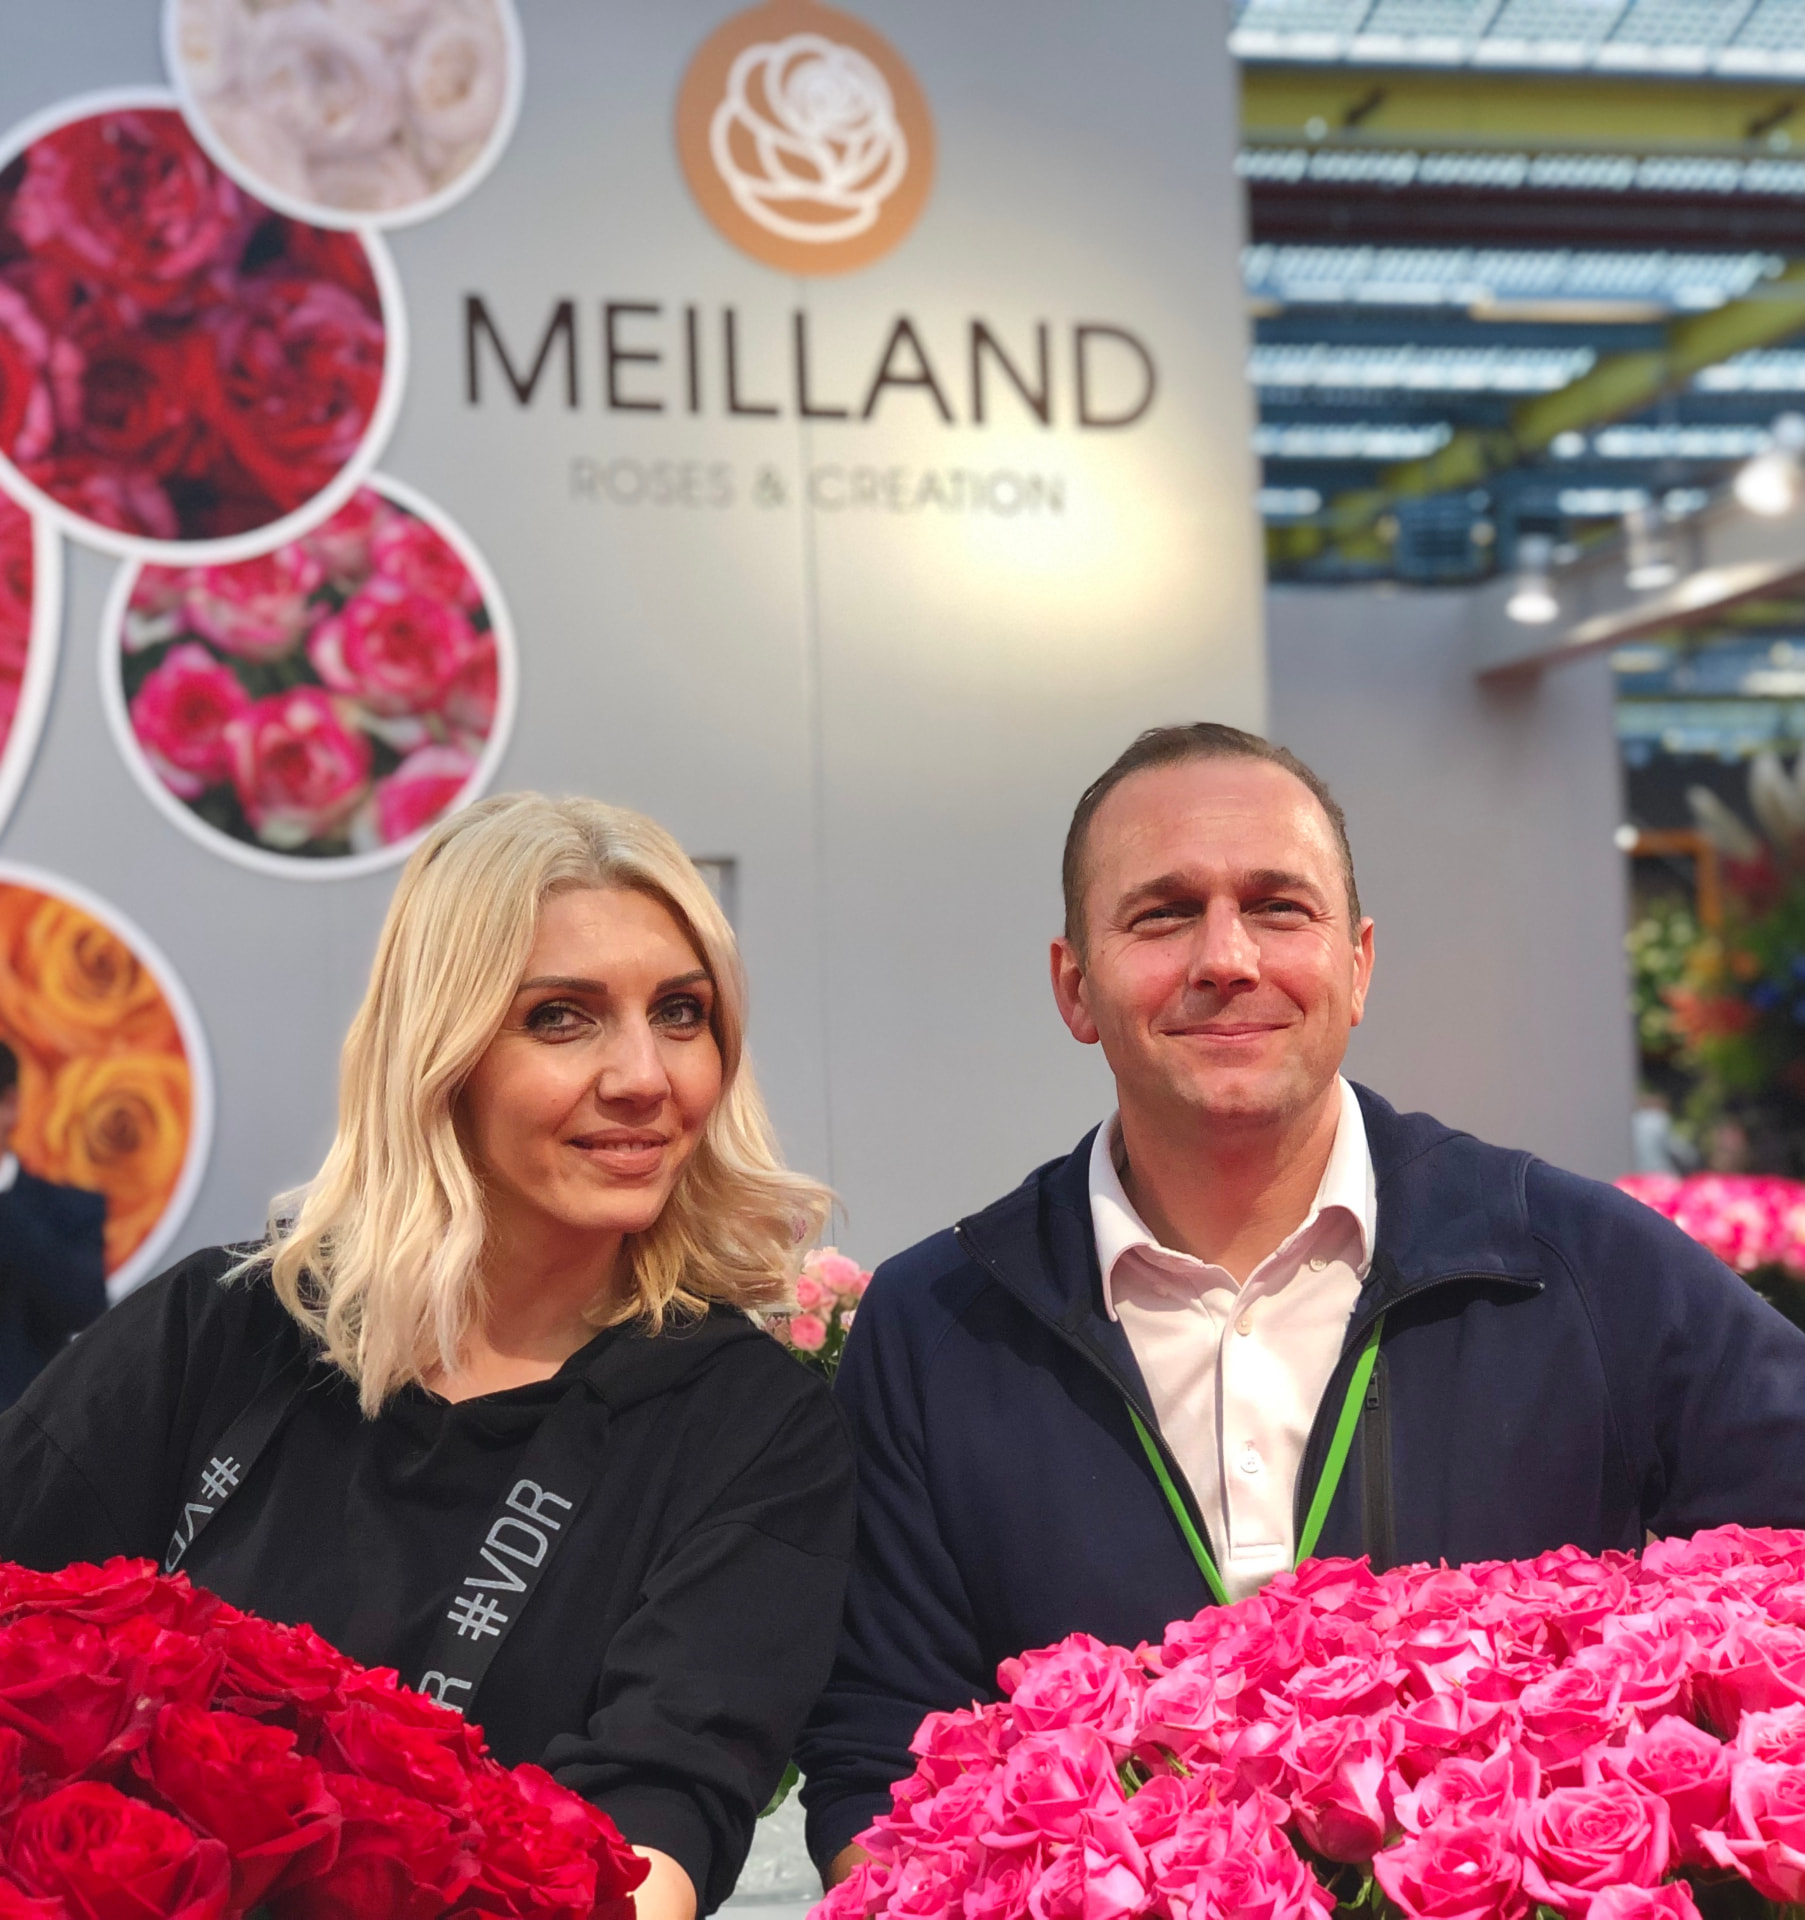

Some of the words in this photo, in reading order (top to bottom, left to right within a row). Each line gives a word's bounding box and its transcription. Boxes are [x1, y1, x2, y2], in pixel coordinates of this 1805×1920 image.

[464, 293, 1158, 430] MEILLAND
[569, 457, 733, 507] ROSES
[753, 462, 785, 509] &
[807, 463, 1066, 516] CREATION
[447, 1478, 573, 1641] #VDR
